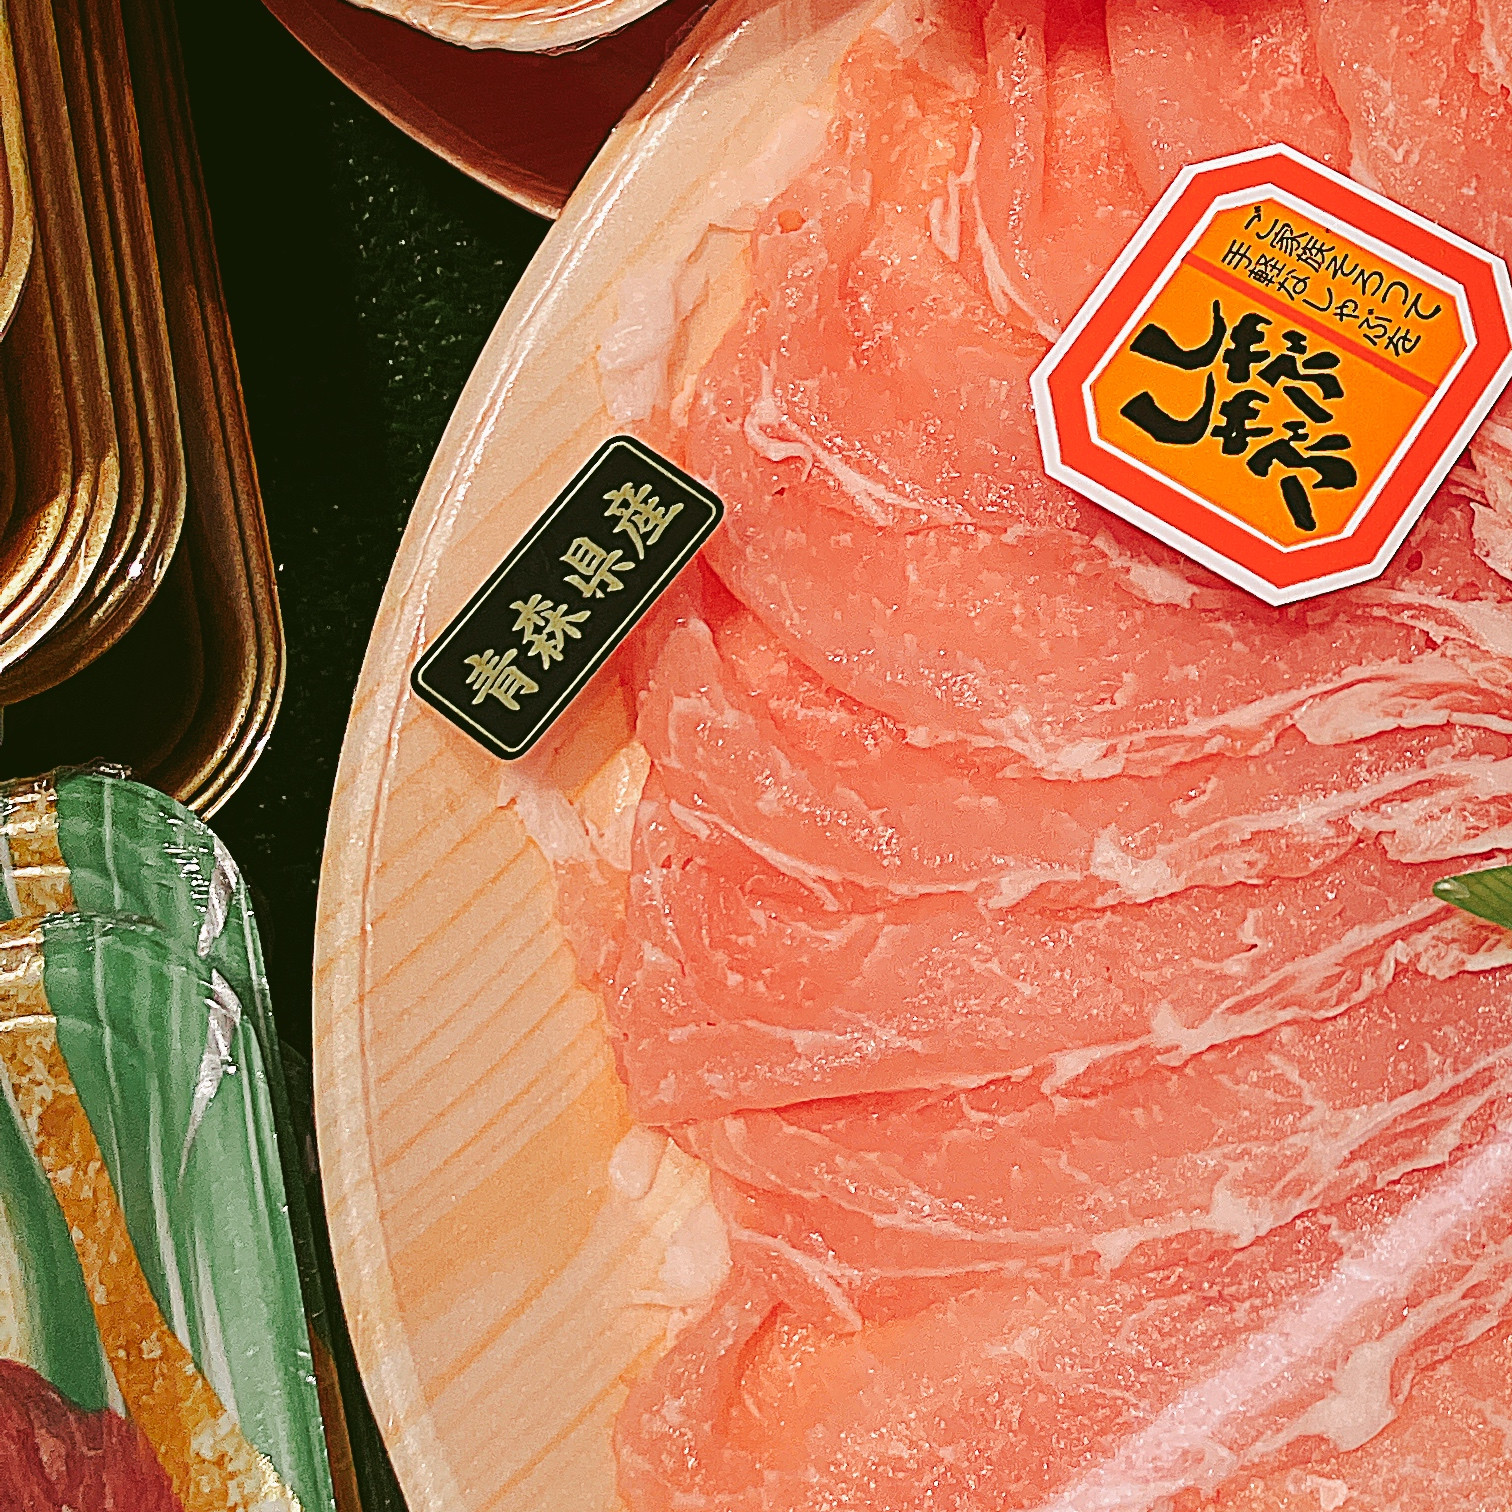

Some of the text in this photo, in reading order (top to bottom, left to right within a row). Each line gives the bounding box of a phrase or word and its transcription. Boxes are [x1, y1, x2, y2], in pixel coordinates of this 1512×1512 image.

[1221, 238, 1422, 357] 手軽なしゃぶを
[1244, 205, 1444, 320] ご家族そろって
[464, 482, 684, 710] 青森県産
